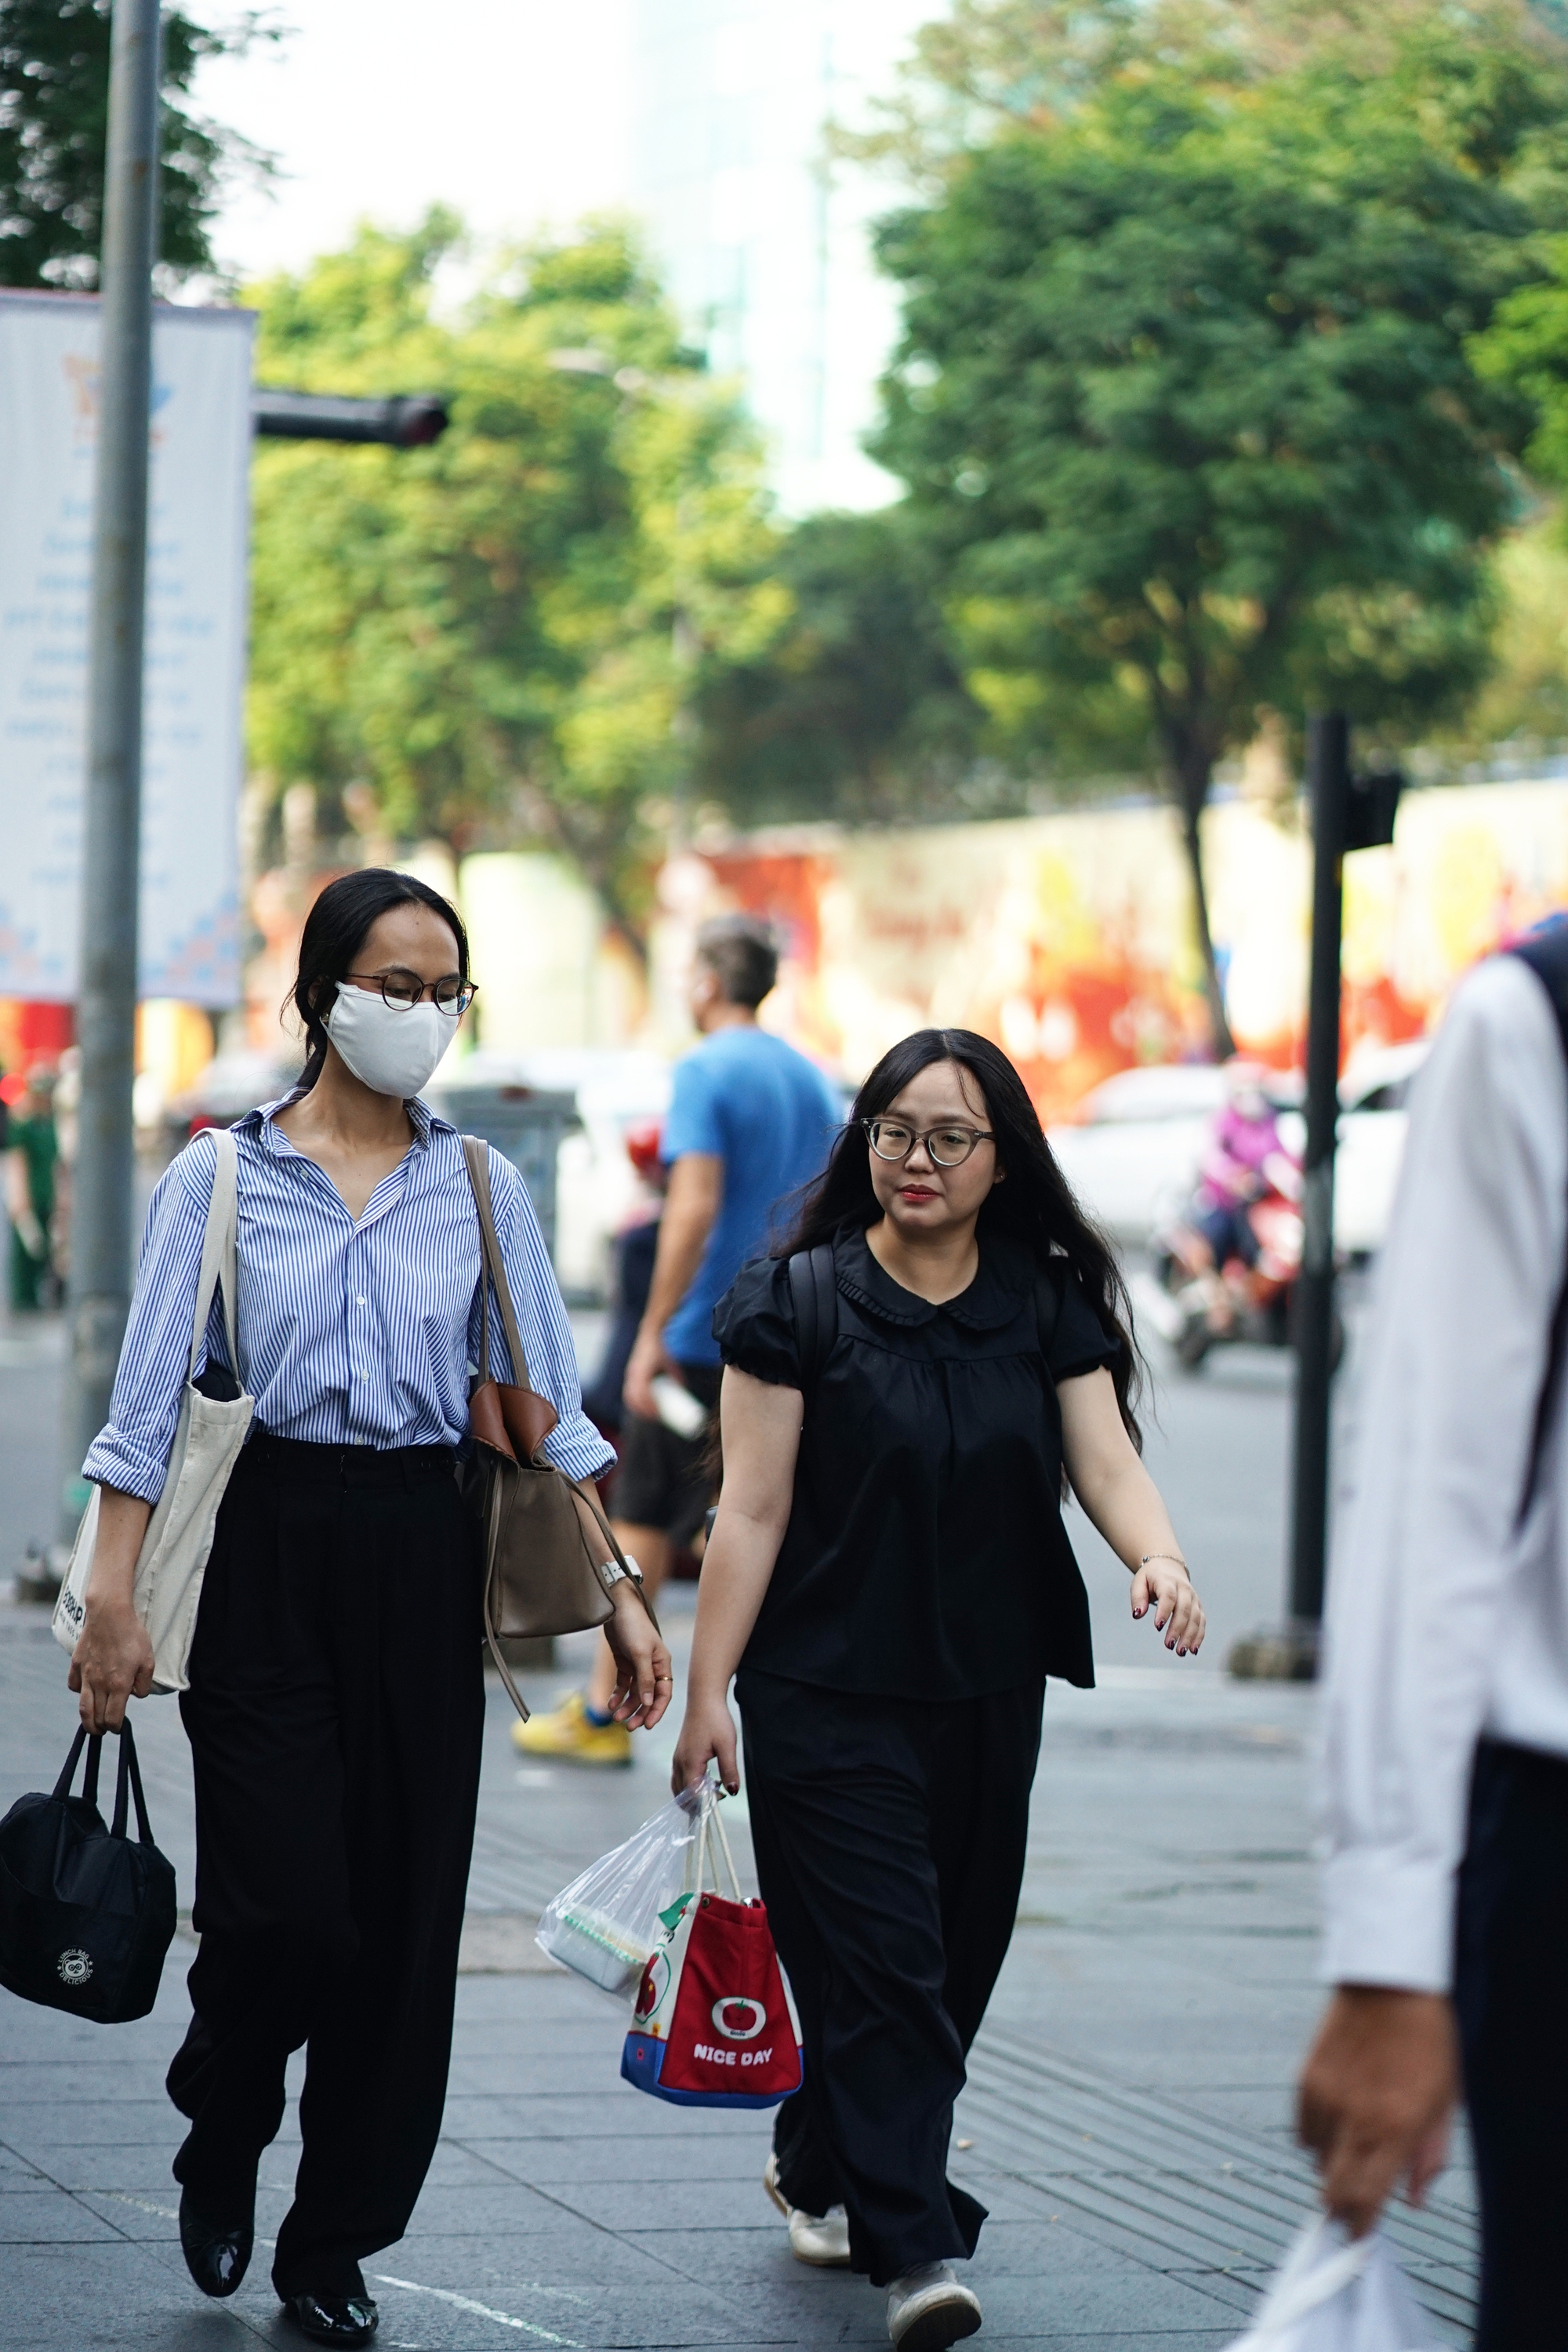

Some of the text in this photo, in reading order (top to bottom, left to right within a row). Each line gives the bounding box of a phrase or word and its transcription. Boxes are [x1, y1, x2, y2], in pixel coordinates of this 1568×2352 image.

[58, 1948, 90, 1962] LUNCH BAG
[59, 1969, 94, 1985] DELICIOUS
[693, 2043, 773, 2067] NICE DAY
